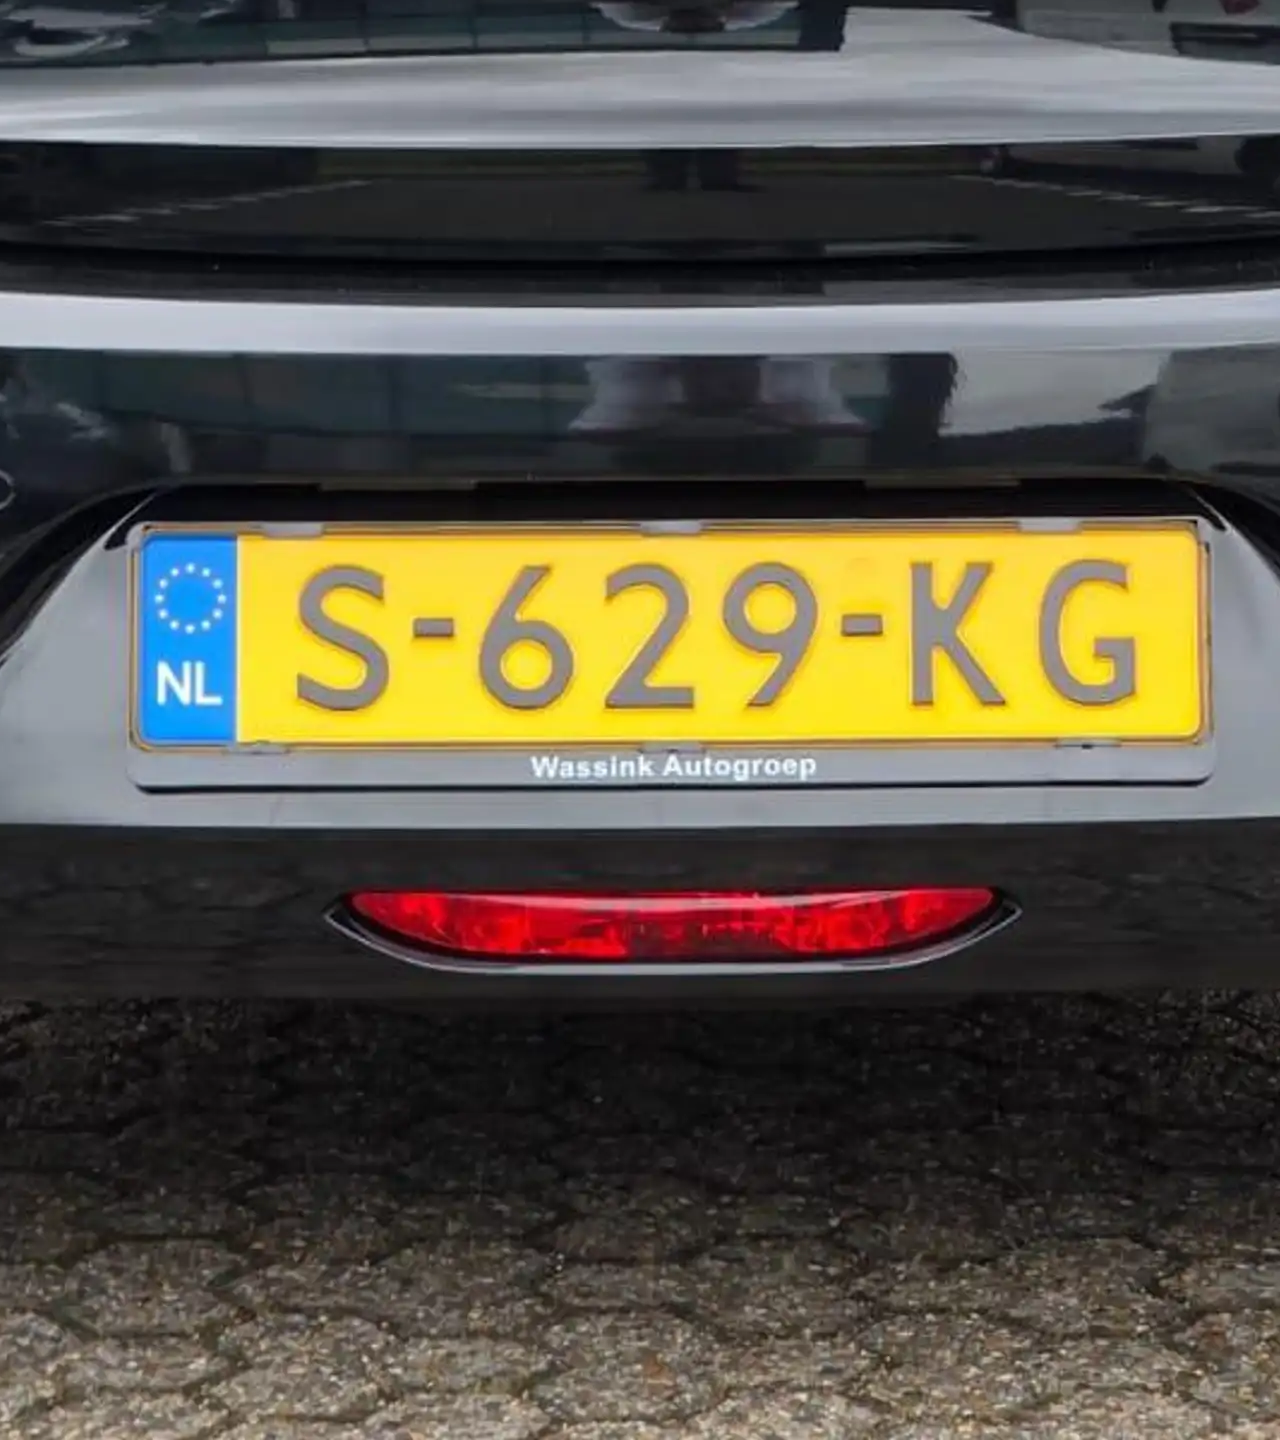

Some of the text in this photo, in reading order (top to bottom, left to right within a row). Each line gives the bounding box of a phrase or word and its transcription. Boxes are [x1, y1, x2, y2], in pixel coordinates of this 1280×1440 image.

[296, 560, 1138, 711] S-629-KG
[156, 663, 222, 706] NL
[530, 756, 817, 781] Wassink Autogroep
